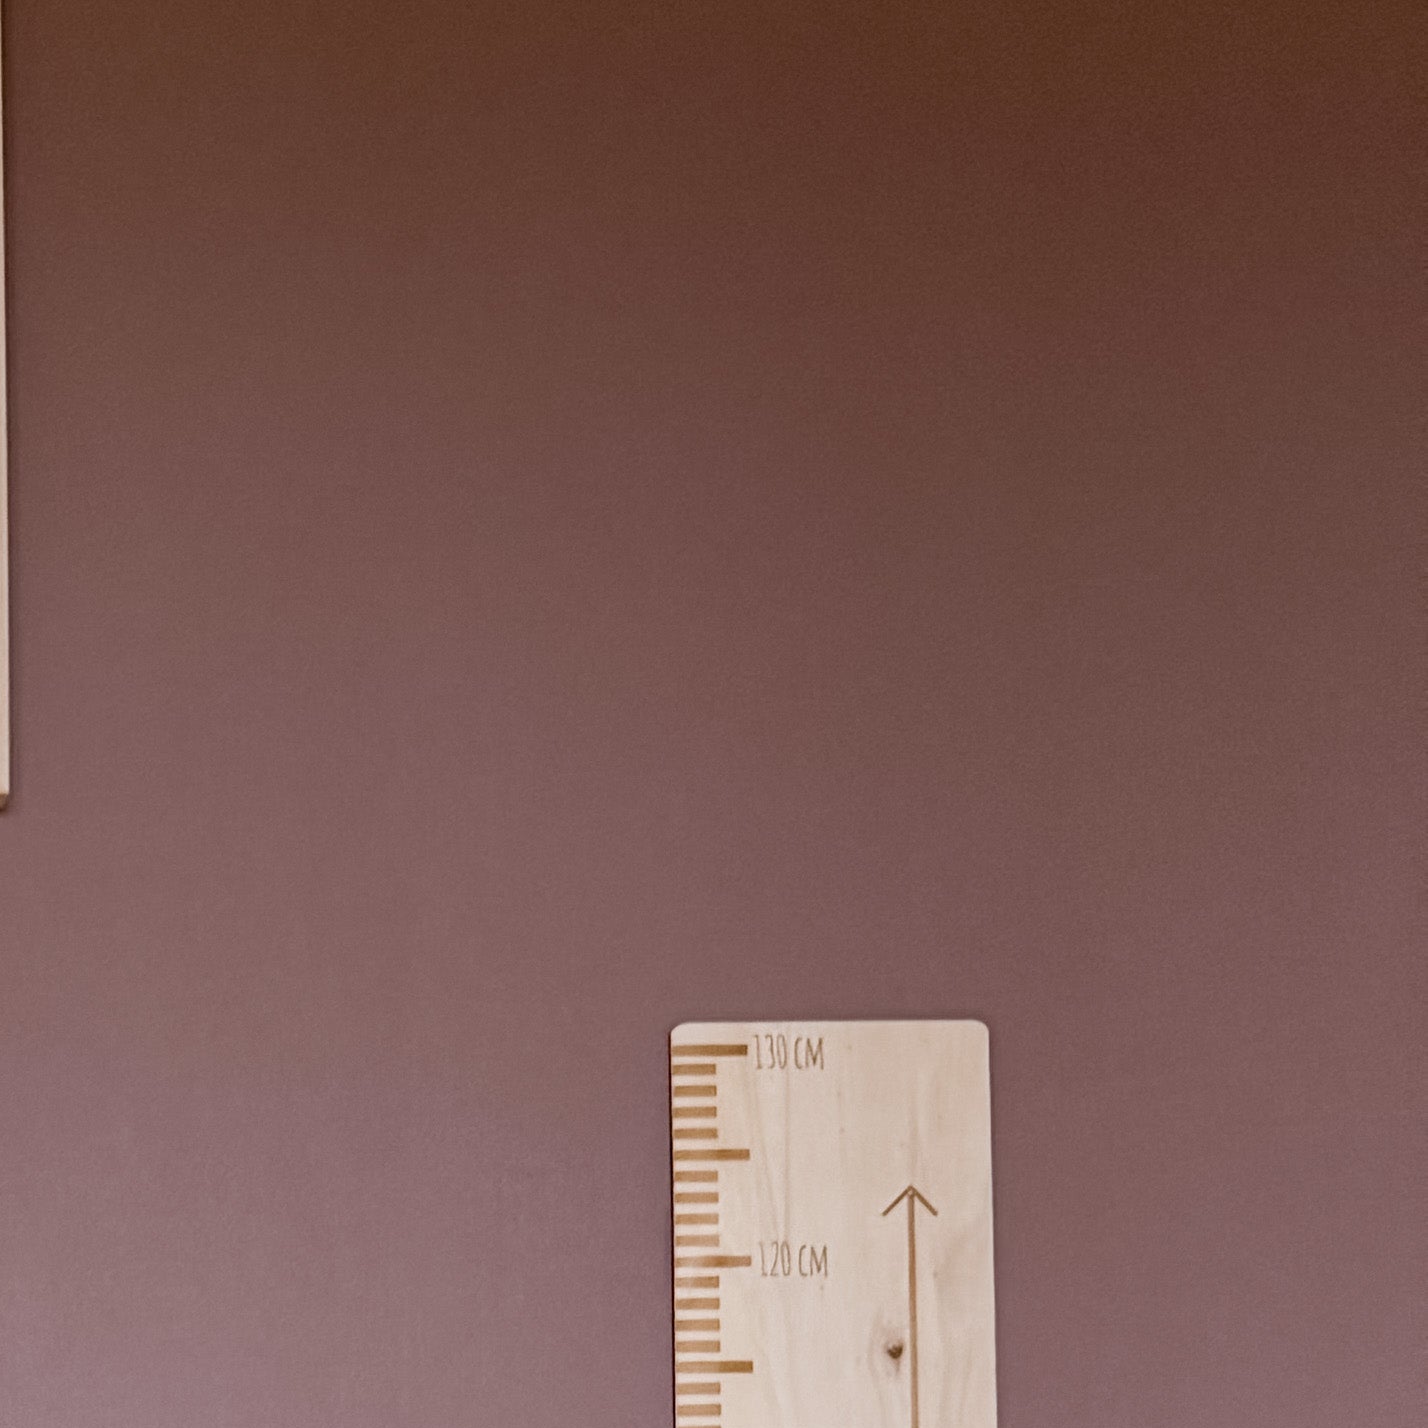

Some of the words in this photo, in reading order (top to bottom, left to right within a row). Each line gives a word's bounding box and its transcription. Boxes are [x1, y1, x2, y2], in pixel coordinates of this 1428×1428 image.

[754, 1034, 788, 1070] 130
[794, 1037, 825, 1070] CM
[759, 1240, 791, 1277] 120
[798, 1244, 828, 1278] CM
